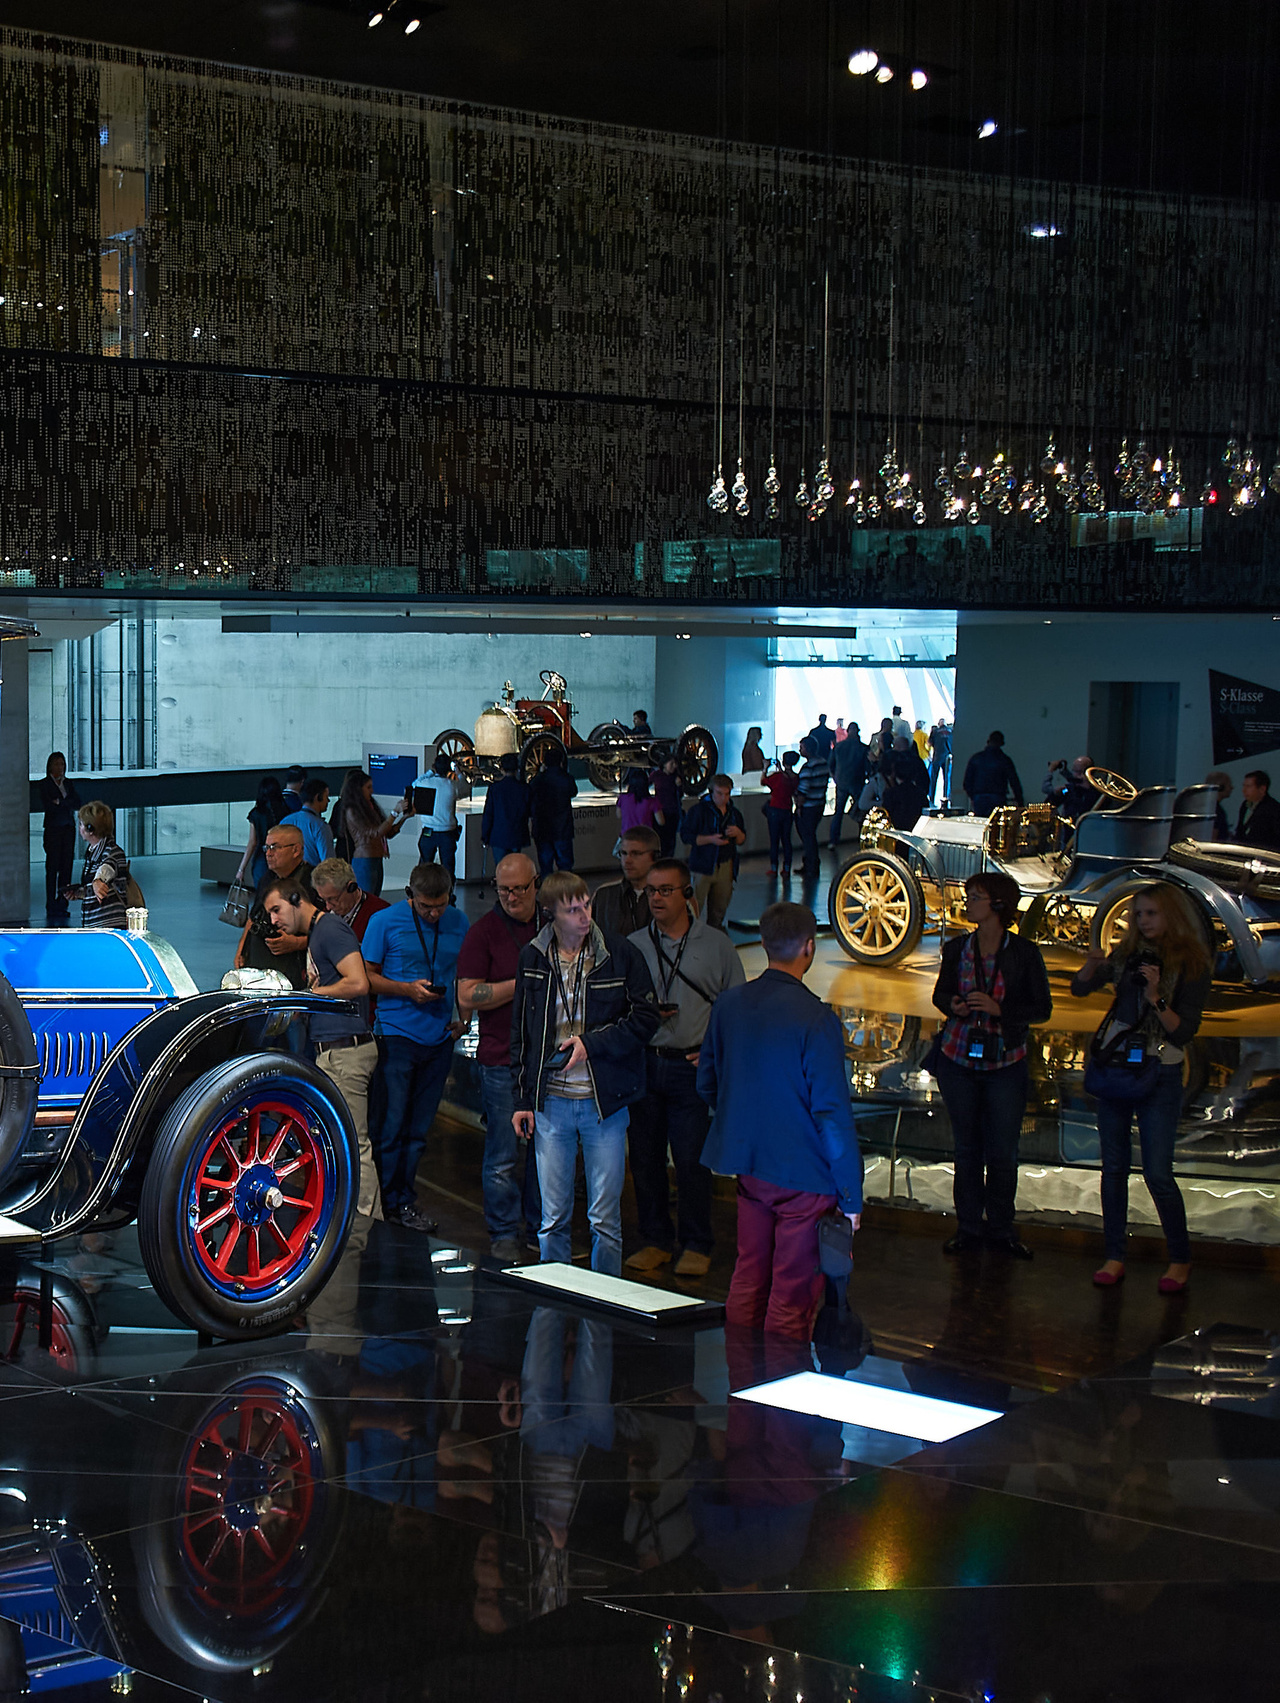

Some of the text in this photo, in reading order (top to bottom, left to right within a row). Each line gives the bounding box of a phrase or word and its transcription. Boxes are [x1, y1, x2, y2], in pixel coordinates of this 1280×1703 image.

[1220, 688, 1264, 702] S-Klasse
[1219, 702, 1257, 714] S-Class
[574, 807, 610, 820] utomobil
